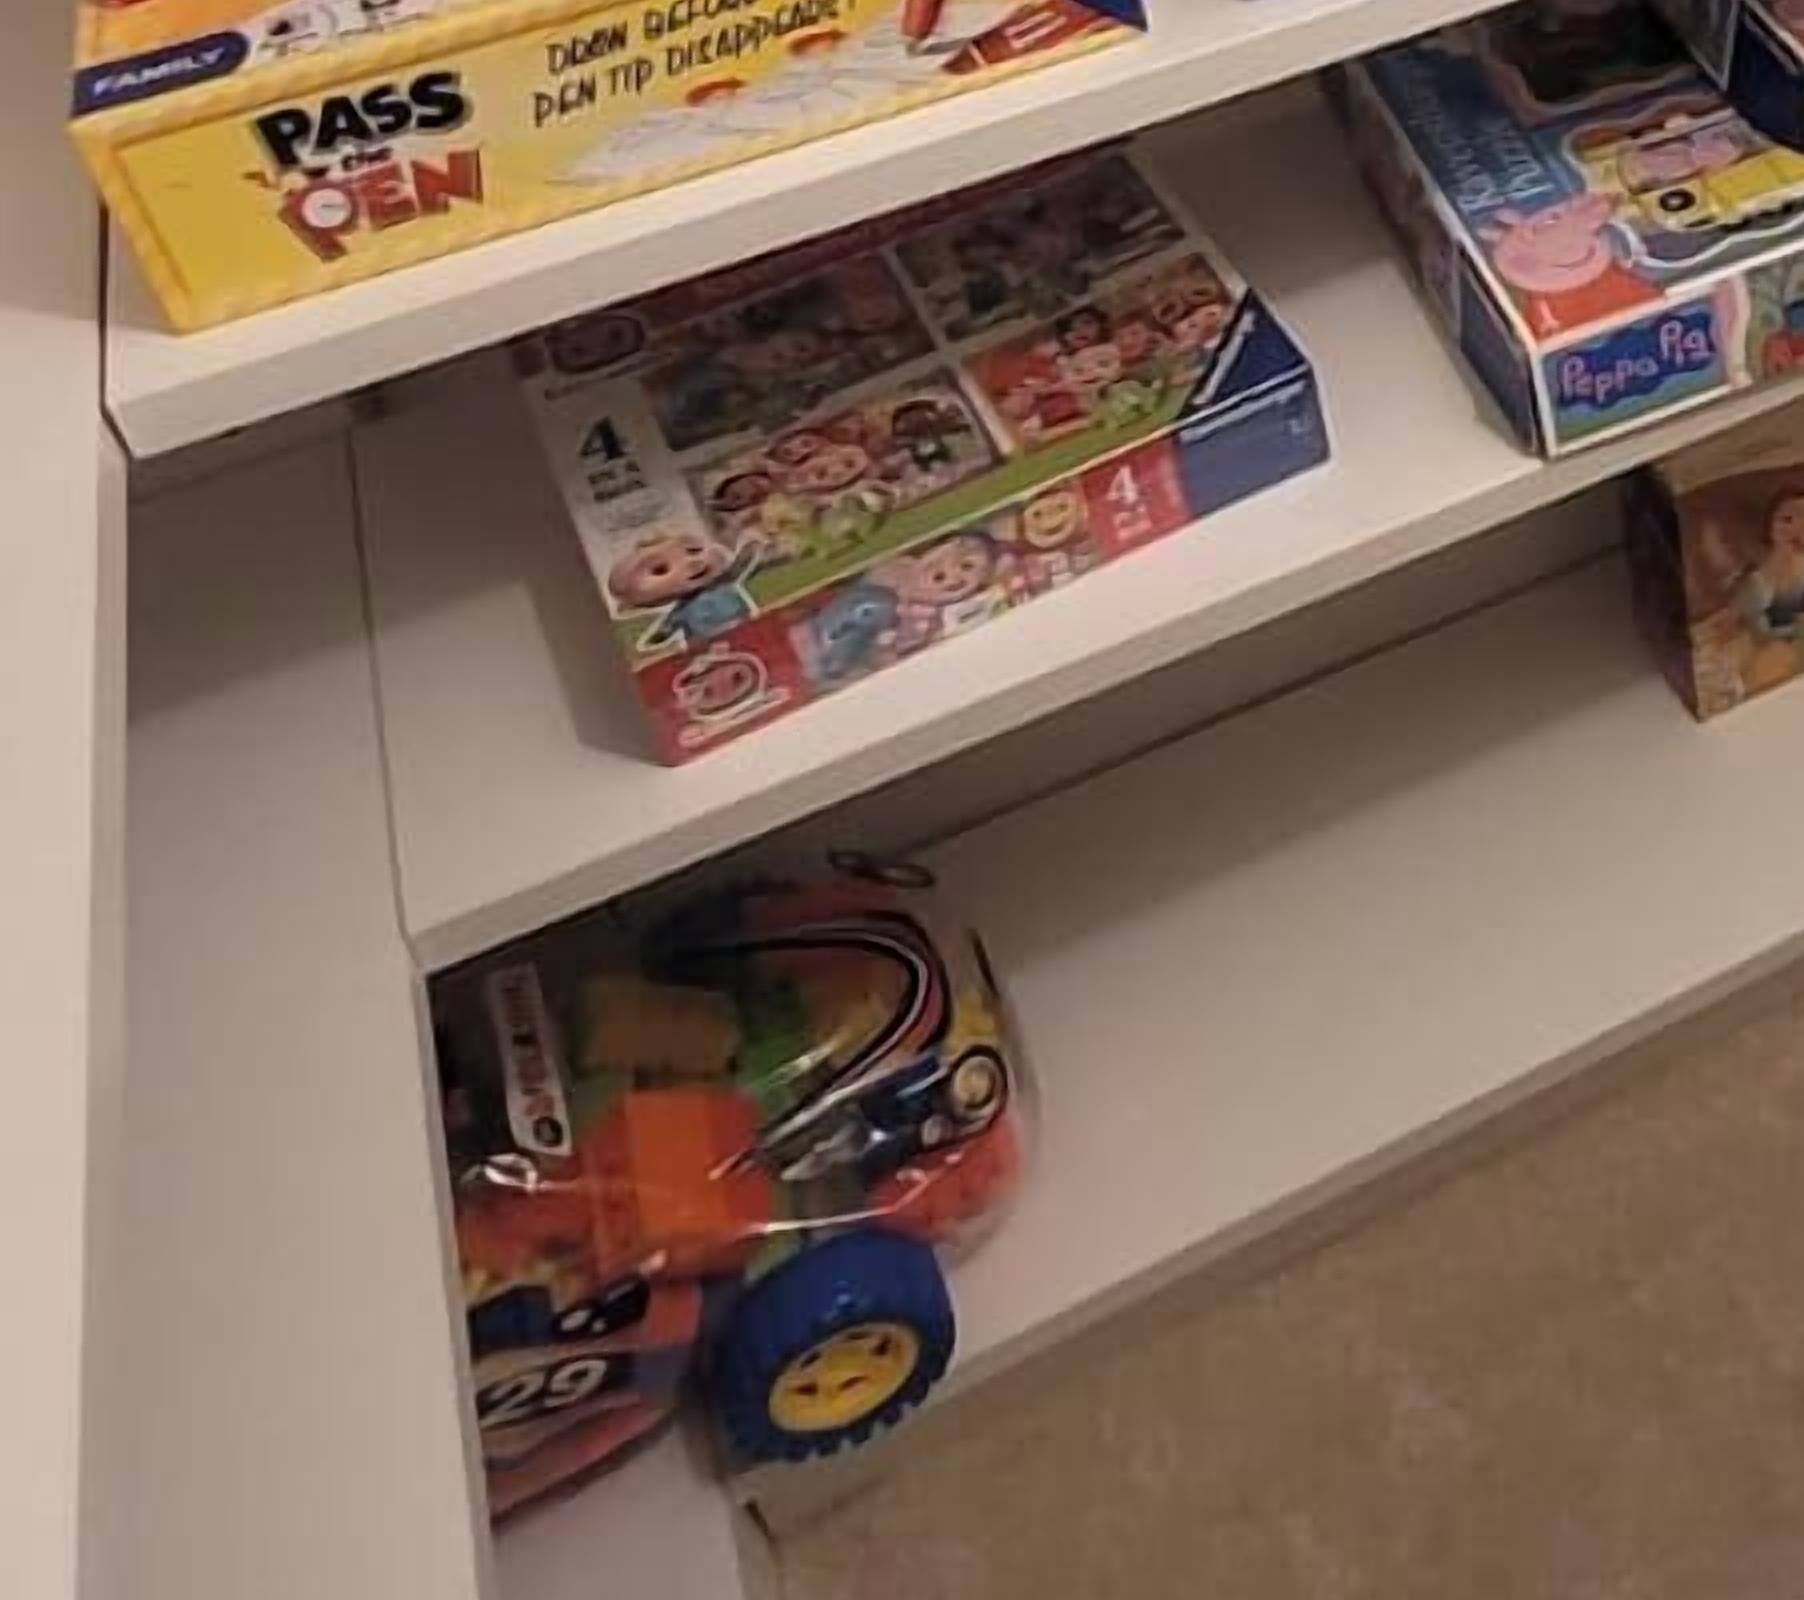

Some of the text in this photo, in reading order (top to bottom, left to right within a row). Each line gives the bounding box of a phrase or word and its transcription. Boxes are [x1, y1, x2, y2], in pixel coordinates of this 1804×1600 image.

[92, 47, 226, 96] FAMILY
[532, 73, 598, 129] PEN
[609, 56, 655, 98] TIP
[256, 71, 469, 168] PASS
[276, 148, 484, 263] PEN
[1563, 318, 1714, 405] Peppa Pig
[579, 415, 629, 462] 4
[1105, 463, 1139, 506] 4
[478, 1358, 608, 1429] 29
